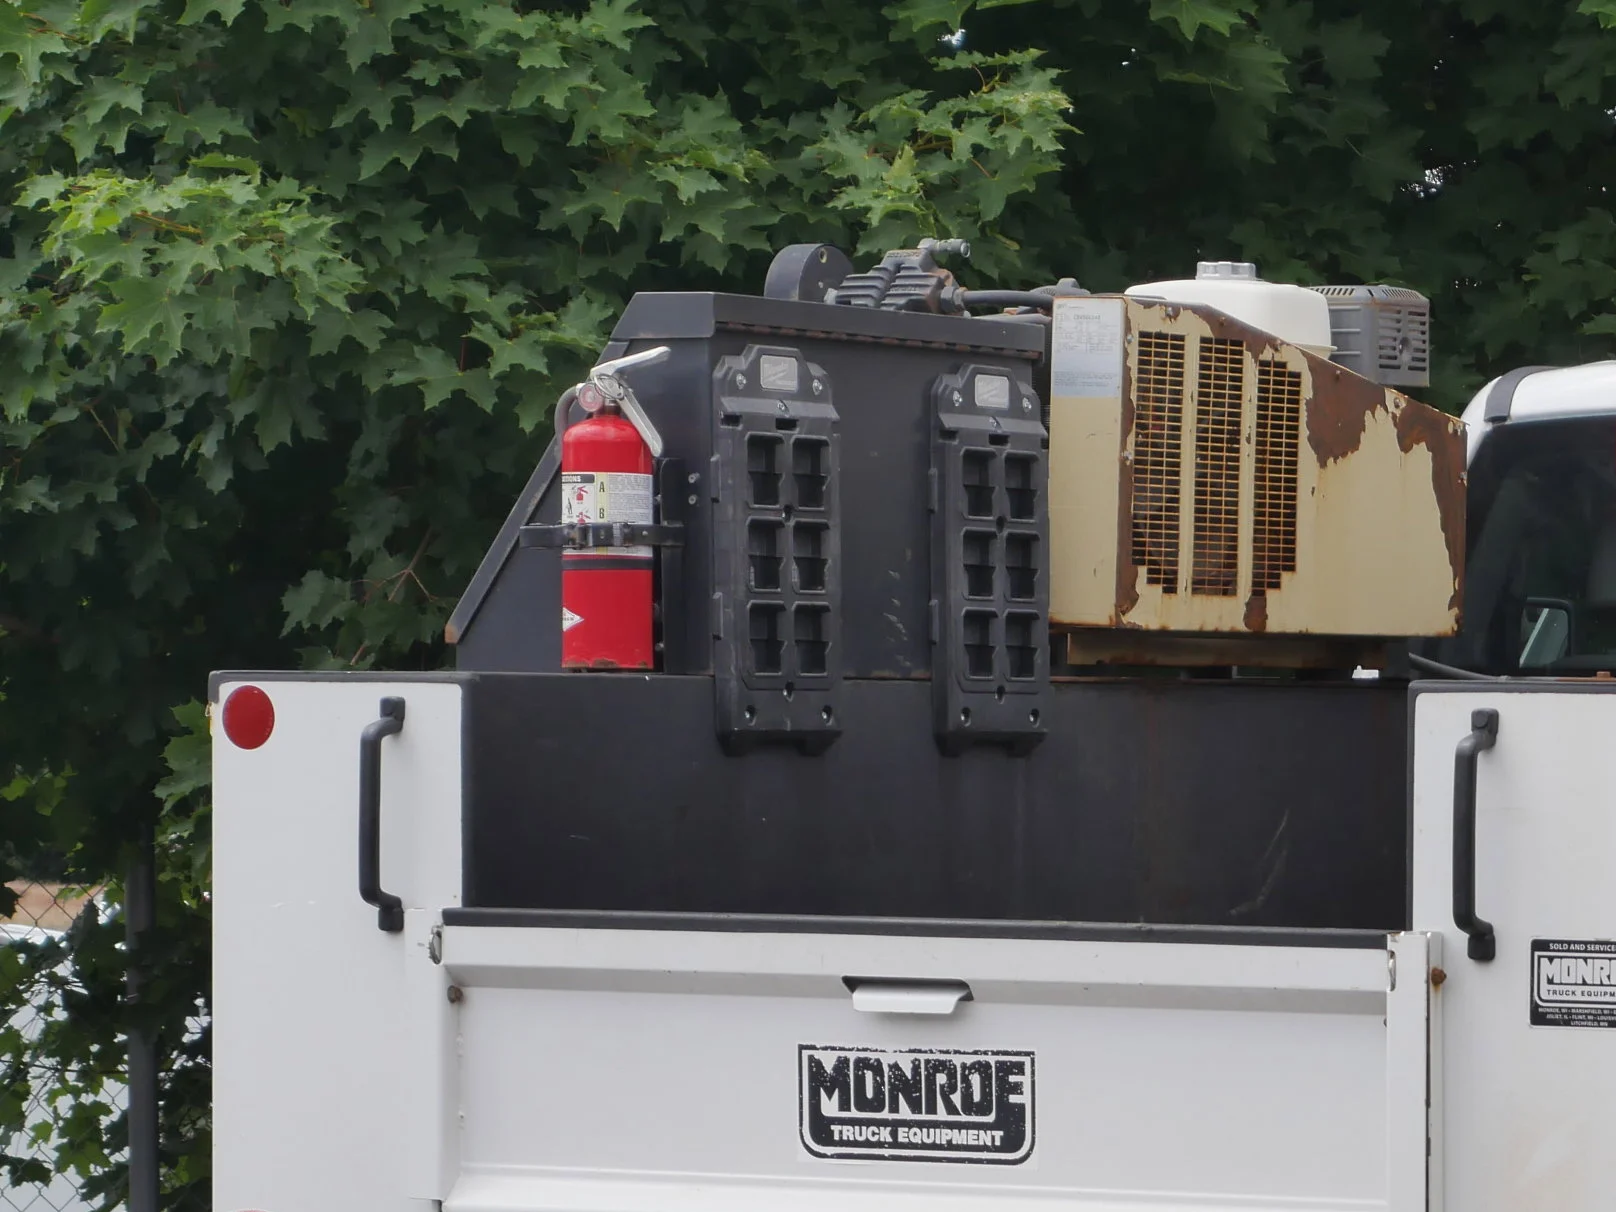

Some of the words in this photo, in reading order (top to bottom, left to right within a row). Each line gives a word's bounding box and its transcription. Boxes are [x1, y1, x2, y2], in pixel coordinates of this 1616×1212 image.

[599, 481, 605, 492] A
[1570, 943, 1585, 951] AND
[1547, 989, 1577, 997] TRUCK
[807, 1054, 1025, 1116] MONROE
[831, 1125, 893, 1142] TRUCK
[898, 1127, 1004, 1146] EQUIPMENT
